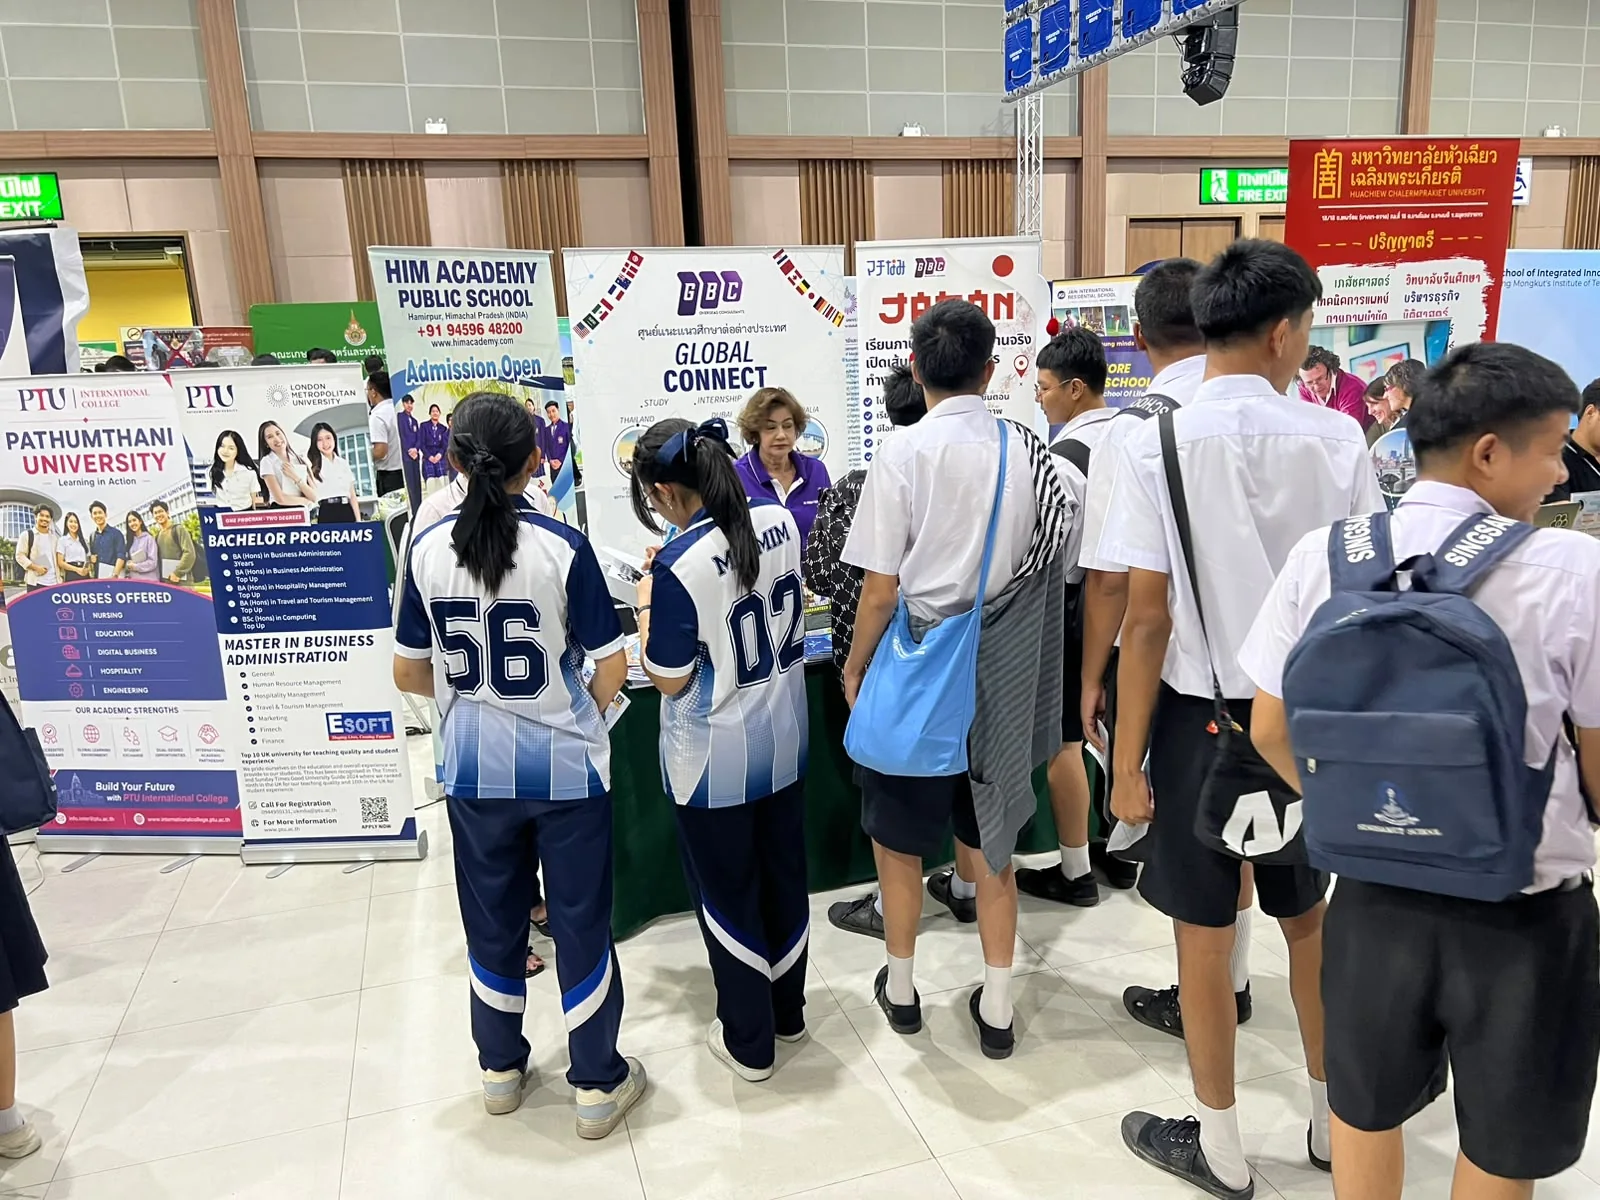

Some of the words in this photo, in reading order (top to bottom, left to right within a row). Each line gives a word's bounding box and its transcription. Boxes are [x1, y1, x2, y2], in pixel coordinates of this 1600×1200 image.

[1352, 144, 1497, 165] มหาวิทยาลัยหัวเฉียว
[1350, 166, 1462, 186] เฉลิมพระเกียรติ
[1238, 190, 1264, 202] FIRE
[1350, 190, 1386, 198] HUACHIEW
[1389, 188, 1446, 197] CHALERMPRAKIET
[1448, 188, 1486, 196] UNIVERSITY
[0, 202, 42, 218] EXIT
[1368, 230, 1435, 253] ปริญญาตรี
[385, 260, 430, 284] HIM
[436, 260, 538, 284] ACADEMY
[1406, 272, 1480, 286] วิทยาลัยจีนศึกษา
[1526, 268, 1536, 276] of
[1537, 268, 1582, 278] Integrated
[1334, 274, 1390, 288] เภสัชศาสตร์
[1513, 280, 1550, 288] Mongkut's
[398, 290, 462, 308] PUBLIC
[467, 289, 534, 308] SCHOOL
[1404, 290, 1460, 305] บริหารธุรกิจ
[408, 312, 444, 322] Hamirpur,
[445, 312, 476, 320] Himachal
[478, 312, 504, 320] Pradesh
[506, 312, 528, 320] (INDIA)
[418, 324, 442, 338] +91
[447, 323, 484, 336] 94596
[488, 322, 523, 335] 48200
[638, 323, 786, 340] ศูนย์แนะแนวศึกษาต่อต่างประเทศ
[431, 338, 514, 348] www.himacademy.com
[996, 334, 1032, 346] านจริง
[676, 341, 754, 365] GLOBAL
[406, 356, 497, 384] Admission
[501, 355, 542, 382] Open
[1108, 364, 1131, 374] ORE
[664, 366, 767, 392] CONNECT
[18, 388, 66, 412] PTU
[80, 388, 149, 398] INTERNATIONAL
[186, 384, 234, 408] PTU
[292, 390, 356, 398] METROPOLITAN
[698, 394, 742, 404] INTERNSHIP
[81, 398, 120, 408] COLLEGE
[620, 416, 654, 424] THAILAND
[6, 428, 174, 450] PATHUMTHANI
[22, 452, 167, 475] UNIVERSITY
[58, 478, 94, 488] Learning
[109, 477, 136, 486] Action
[208, 533, 286, 547] BACHELOR
[290, 529, 373, 544] PROGRAMS
[1344, 514, 1376, 563] SINGSA
[275, 582, 308, 590] Hospitality
[309, 582, 347, 590] Management
[52, 592, 112, 604] COURSES
[116, 592, 172, 604] OFFERED
[334, 596, 373, 604] Management
[726, 569, 806, 690] 02
[225, 638, 280, 650] MASTER
[284, 637, 300, 648] IN
[304, 635, 374, 648] BUSINESS
[430, 596, 548, 702] 56
[227, 651, 348, 666] ADMINISTRATION
[305, 702, 344, 710] Management
[328, 714, 390, 733] ESOFT
[96, 782, 119, 792] Build
[121, 782, 142, 792] Your
[144, 782, 175, 792] Future
[196, 794, 228, 804] College
[288, 800, 332, 809] Registration
